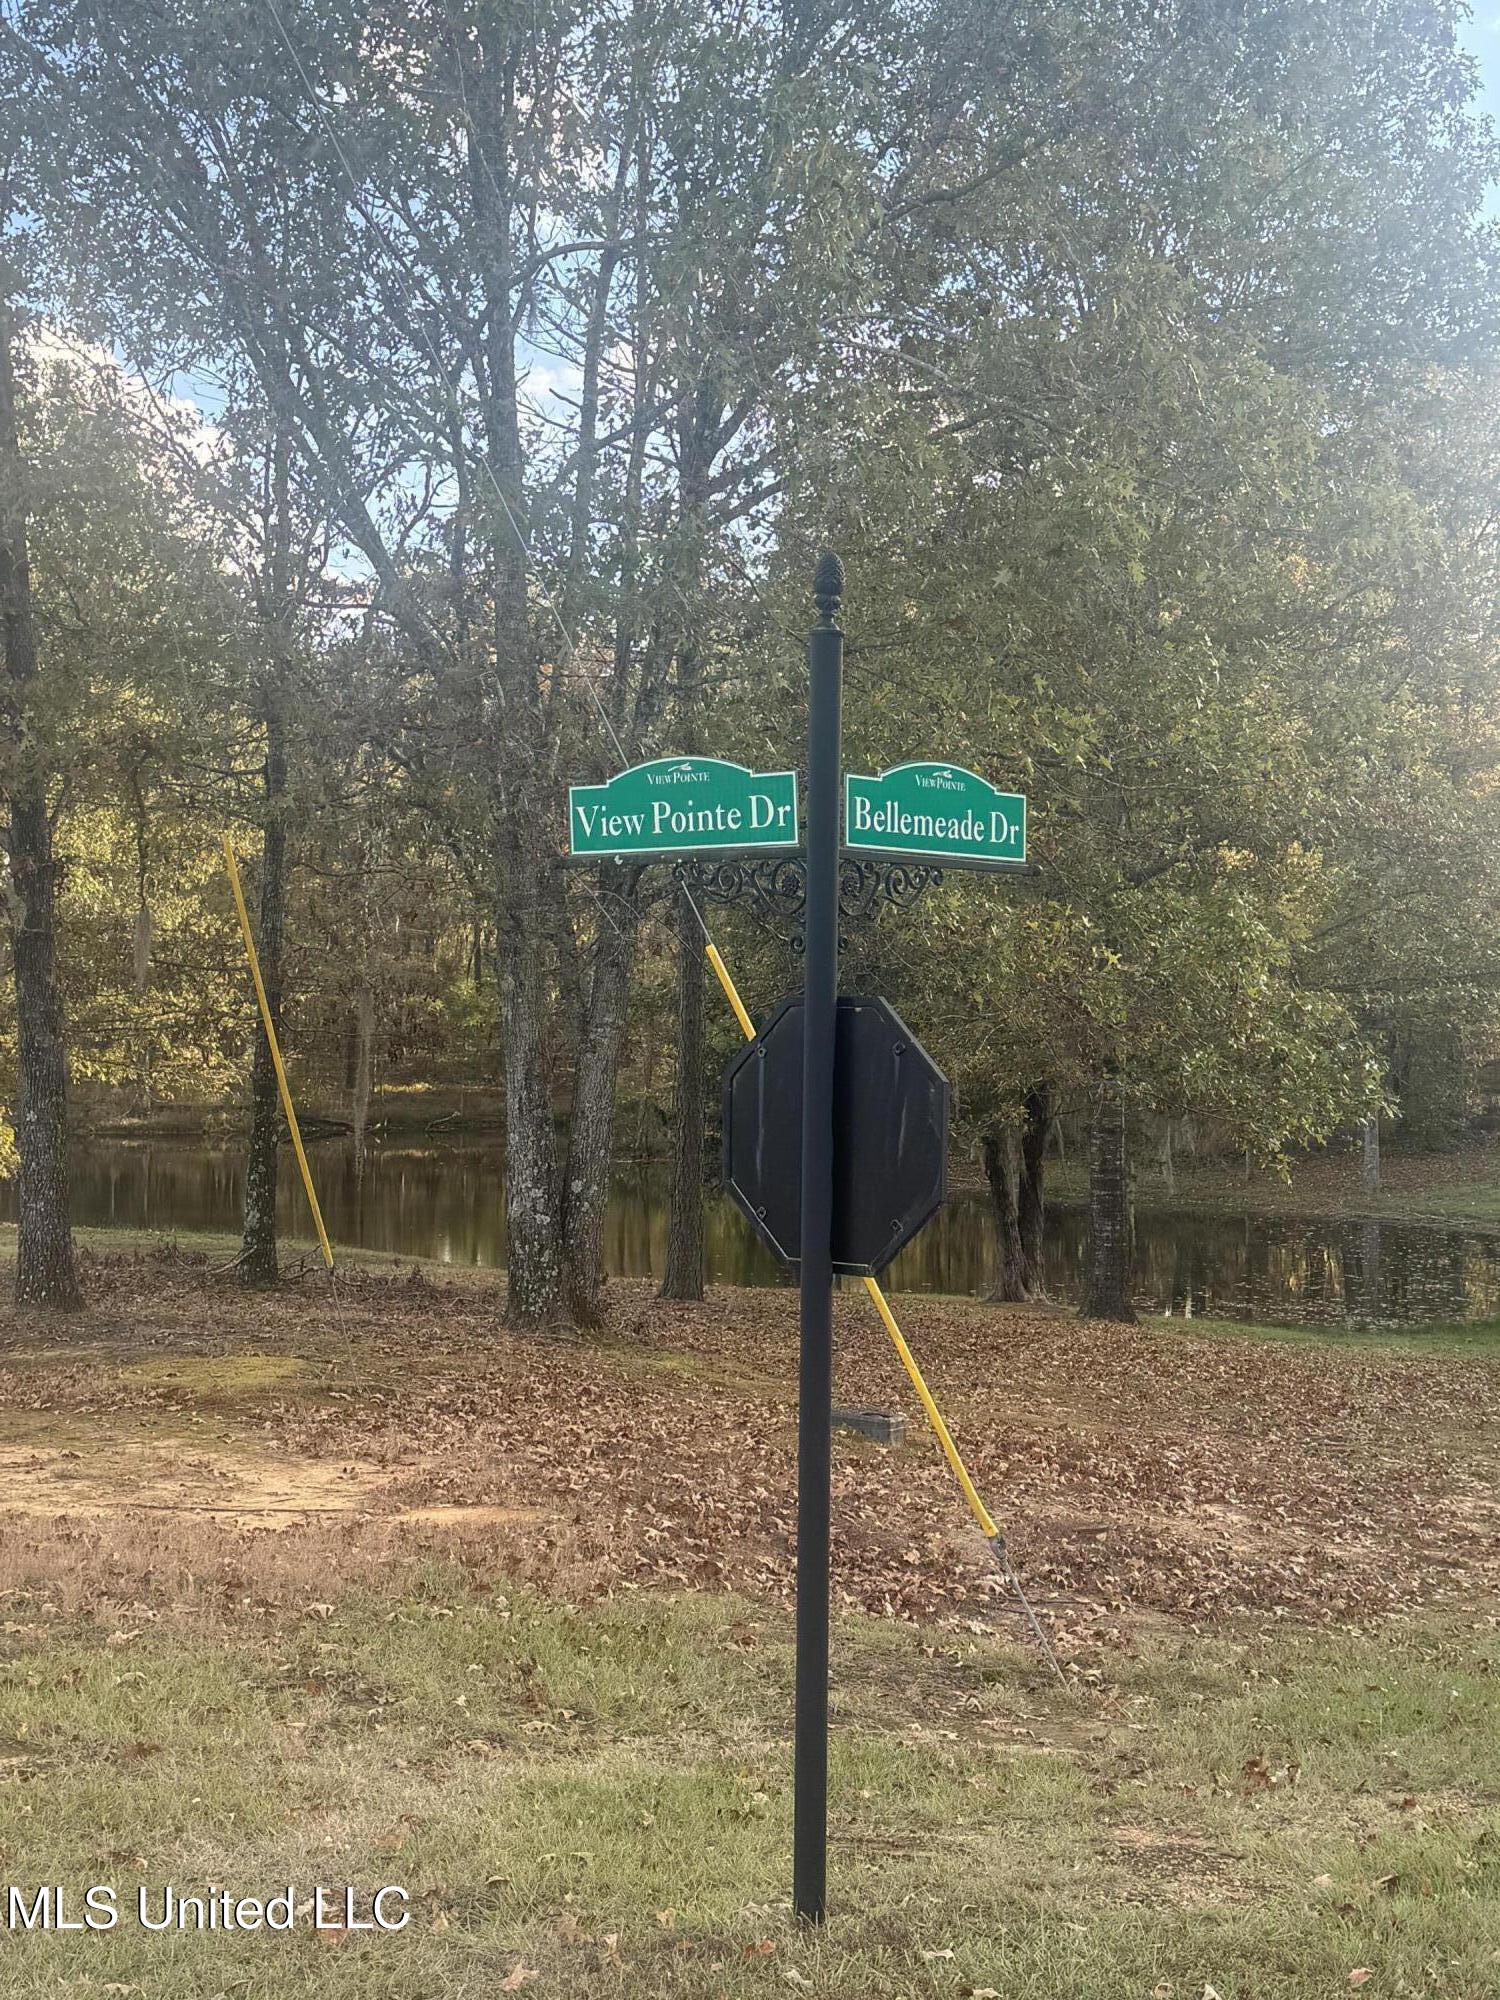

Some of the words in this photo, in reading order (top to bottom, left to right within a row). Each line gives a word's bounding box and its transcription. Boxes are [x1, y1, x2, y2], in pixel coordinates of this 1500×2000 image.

[576, 805, 644, 838] View
[653, 800, 742, 835] Pointe
[749, 794, 791, 829] Dr
[854, 796, 984, 842] Bellemeade
[990, 811, 1019, 845] Dr
